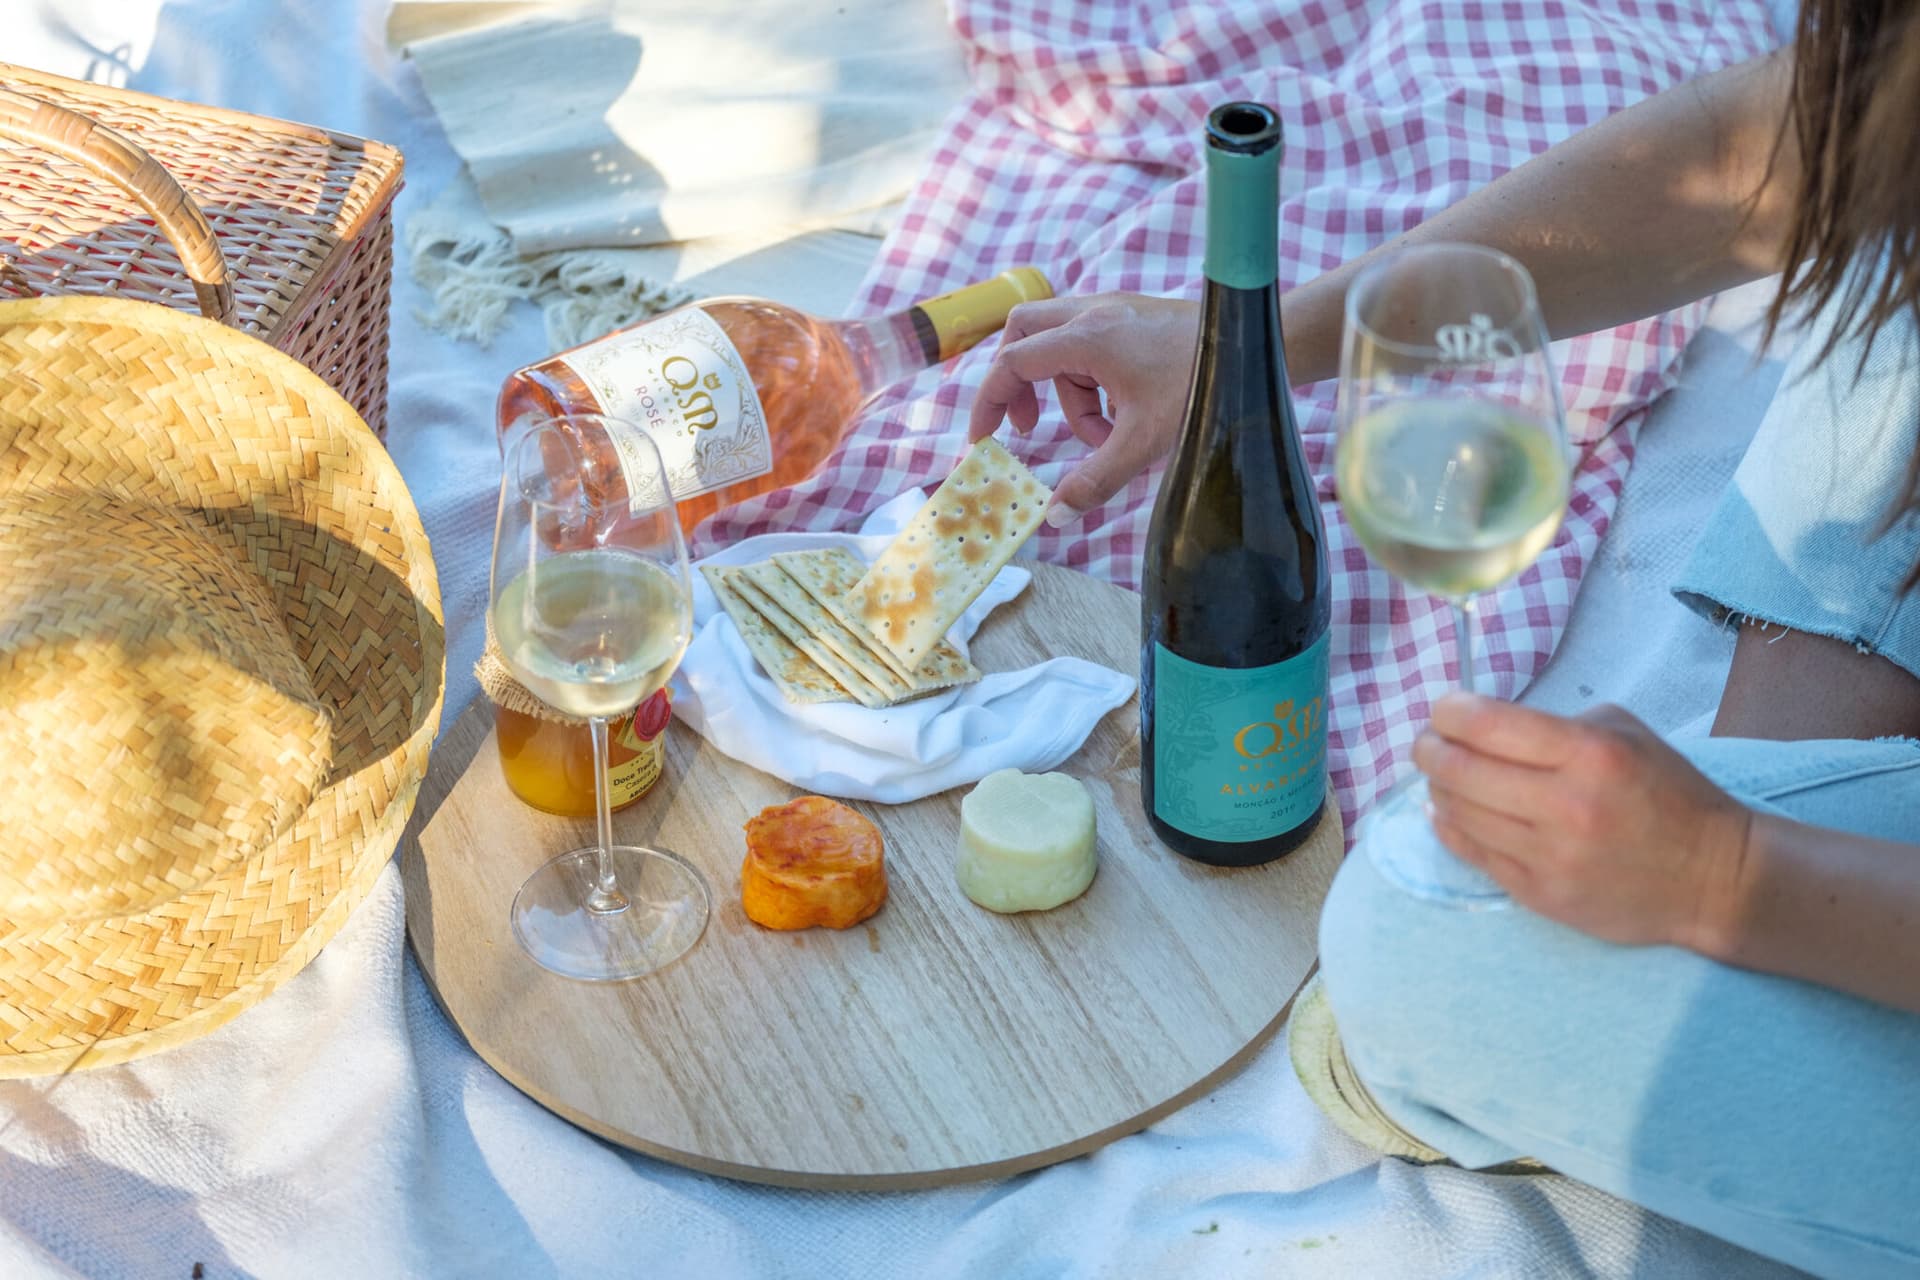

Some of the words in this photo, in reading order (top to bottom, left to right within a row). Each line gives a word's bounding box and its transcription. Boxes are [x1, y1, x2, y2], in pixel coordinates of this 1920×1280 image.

[635, 386, 665, 429] ROSÉ
[662, 356, 718, 435] QM
[1233, 697, 1321, 759] QM
[614, 773, 635, 787] Doce
